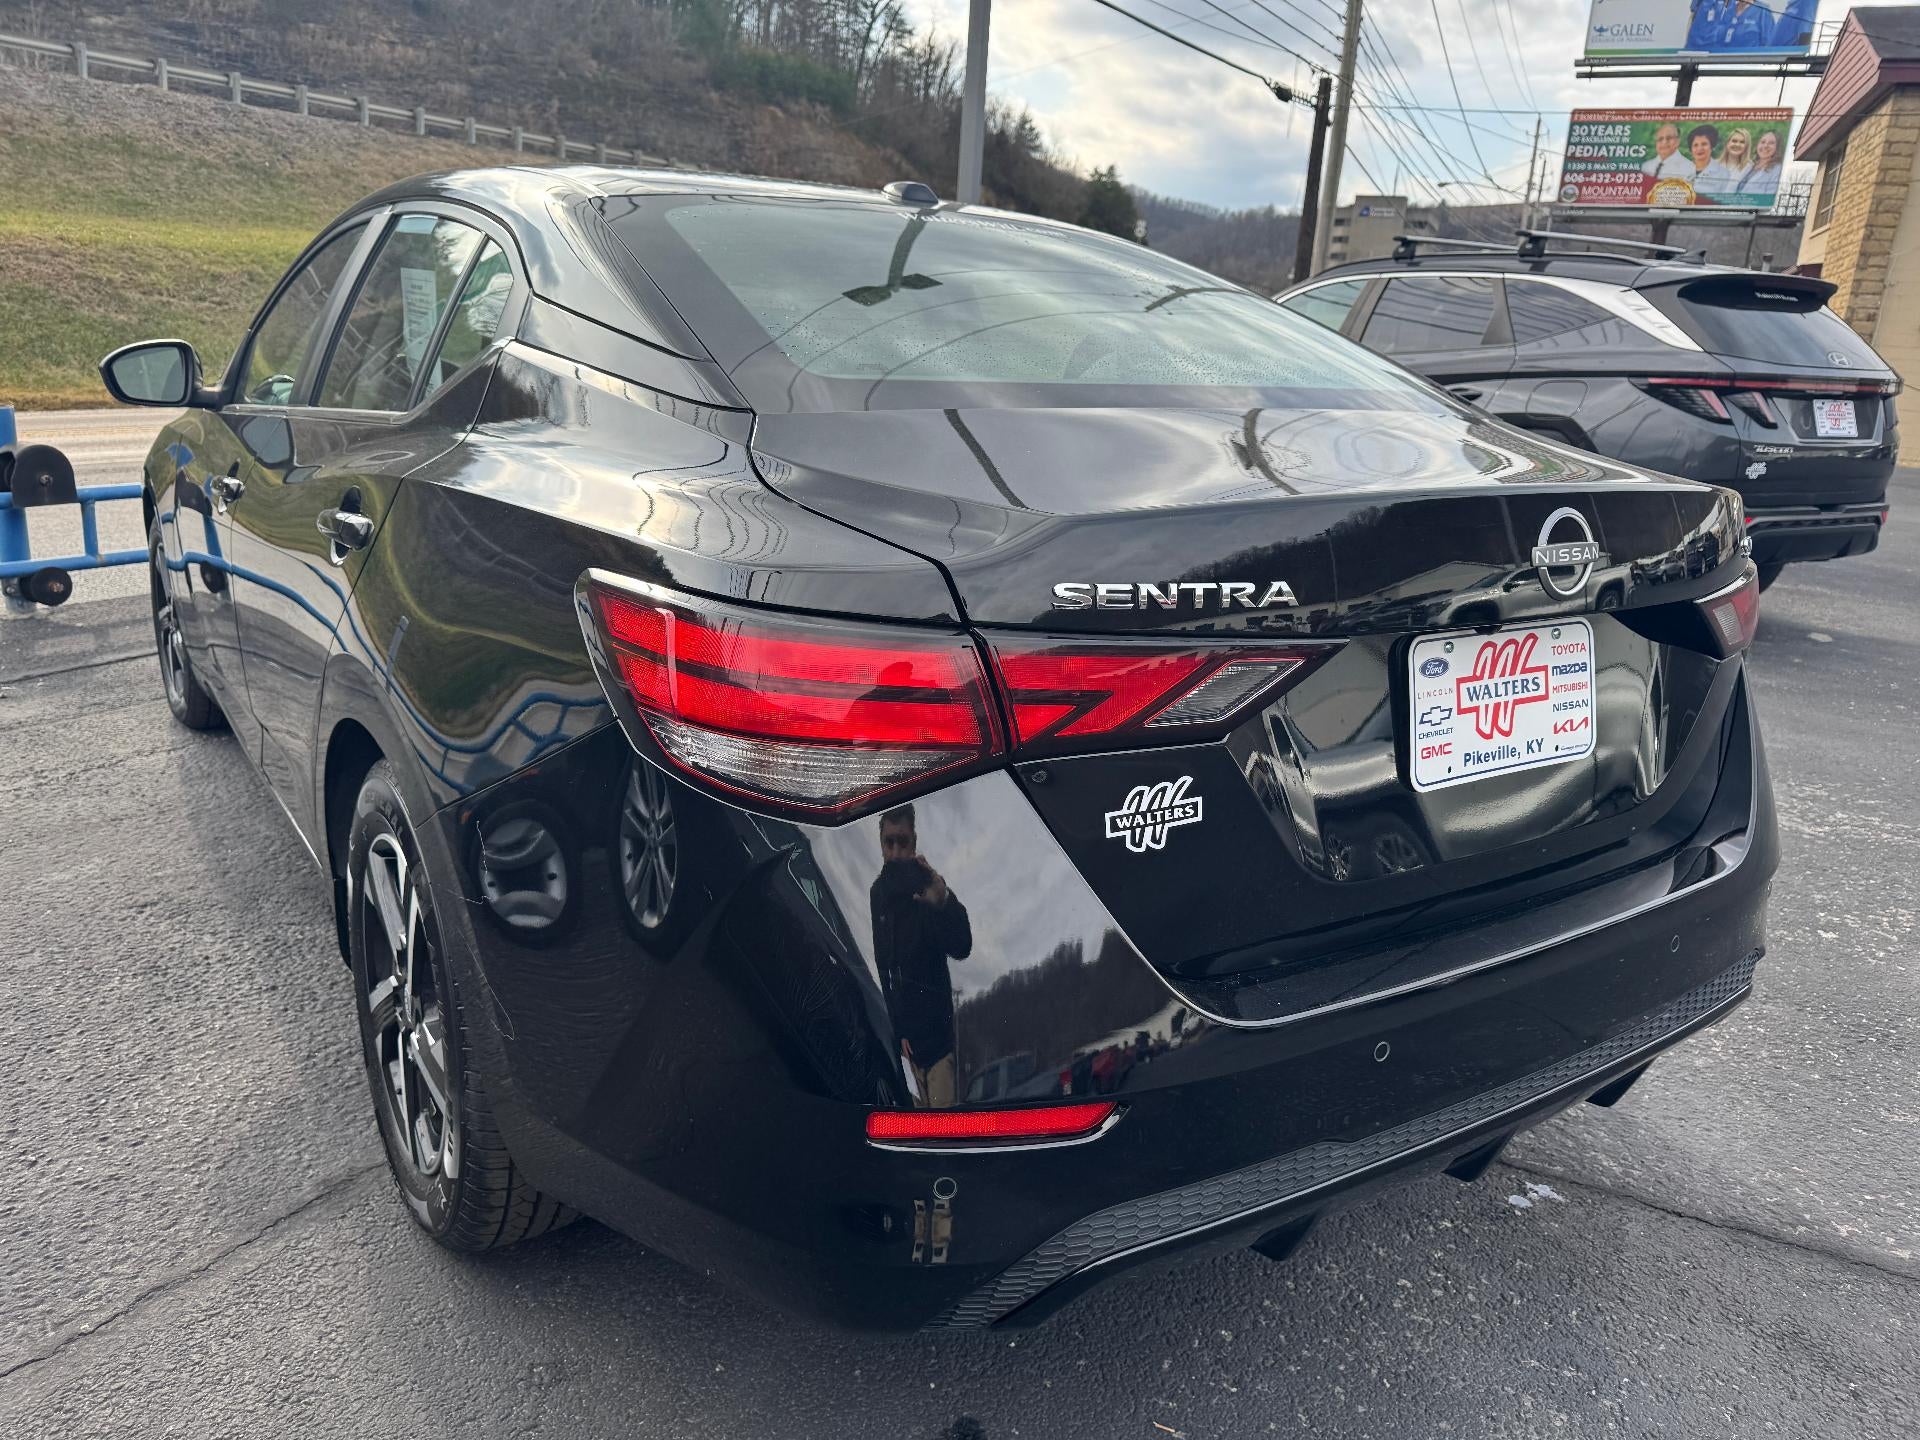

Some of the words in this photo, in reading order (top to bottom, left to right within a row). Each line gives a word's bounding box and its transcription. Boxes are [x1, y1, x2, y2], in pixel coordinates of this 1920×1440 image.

[1610, 23, 1654, 36] GALEN
[1680, 111, 1728, 120] CHILDREN
[1743, 111, 1788, 120] FAMILIES
[1572, 125, 1588, 136] 30
[1589, 125, 1631, 136] YEARS
[1567, 145, 1647, 158] PEDIATRICS
[1618, 162, 1640, 170] TRAIL
[1564, 172, 1644, 184] 606-432-0123
[1581, 185, 1643, 196] MOUNTAIN
[1535, 547, 1599, 564] NISSAN
[1052, 581, 1300, 609] SENTRA
[1551, 642, 1587, 656] TOYOTA
[1425, 661, 1444, 675] Ford
[1417, 687, 1453, 699] LINCOLN
[1466, 676, 1541, 702] WALTERS
[1552, 681, 1588, 694] MITSUBISHI
[1552, 698, 1588, 712] NISSAN
[1553, 716, 1588, 734] KIA
[1418, 727, 1454, 740] CHEVROLET
[1421, 742, 1452, 760] GMC
[1463, 746, 1521, 767] Pikeville,
[1526, 738, 1544, 755] KY
[1115, 804, 1195, 829] WALTERS
